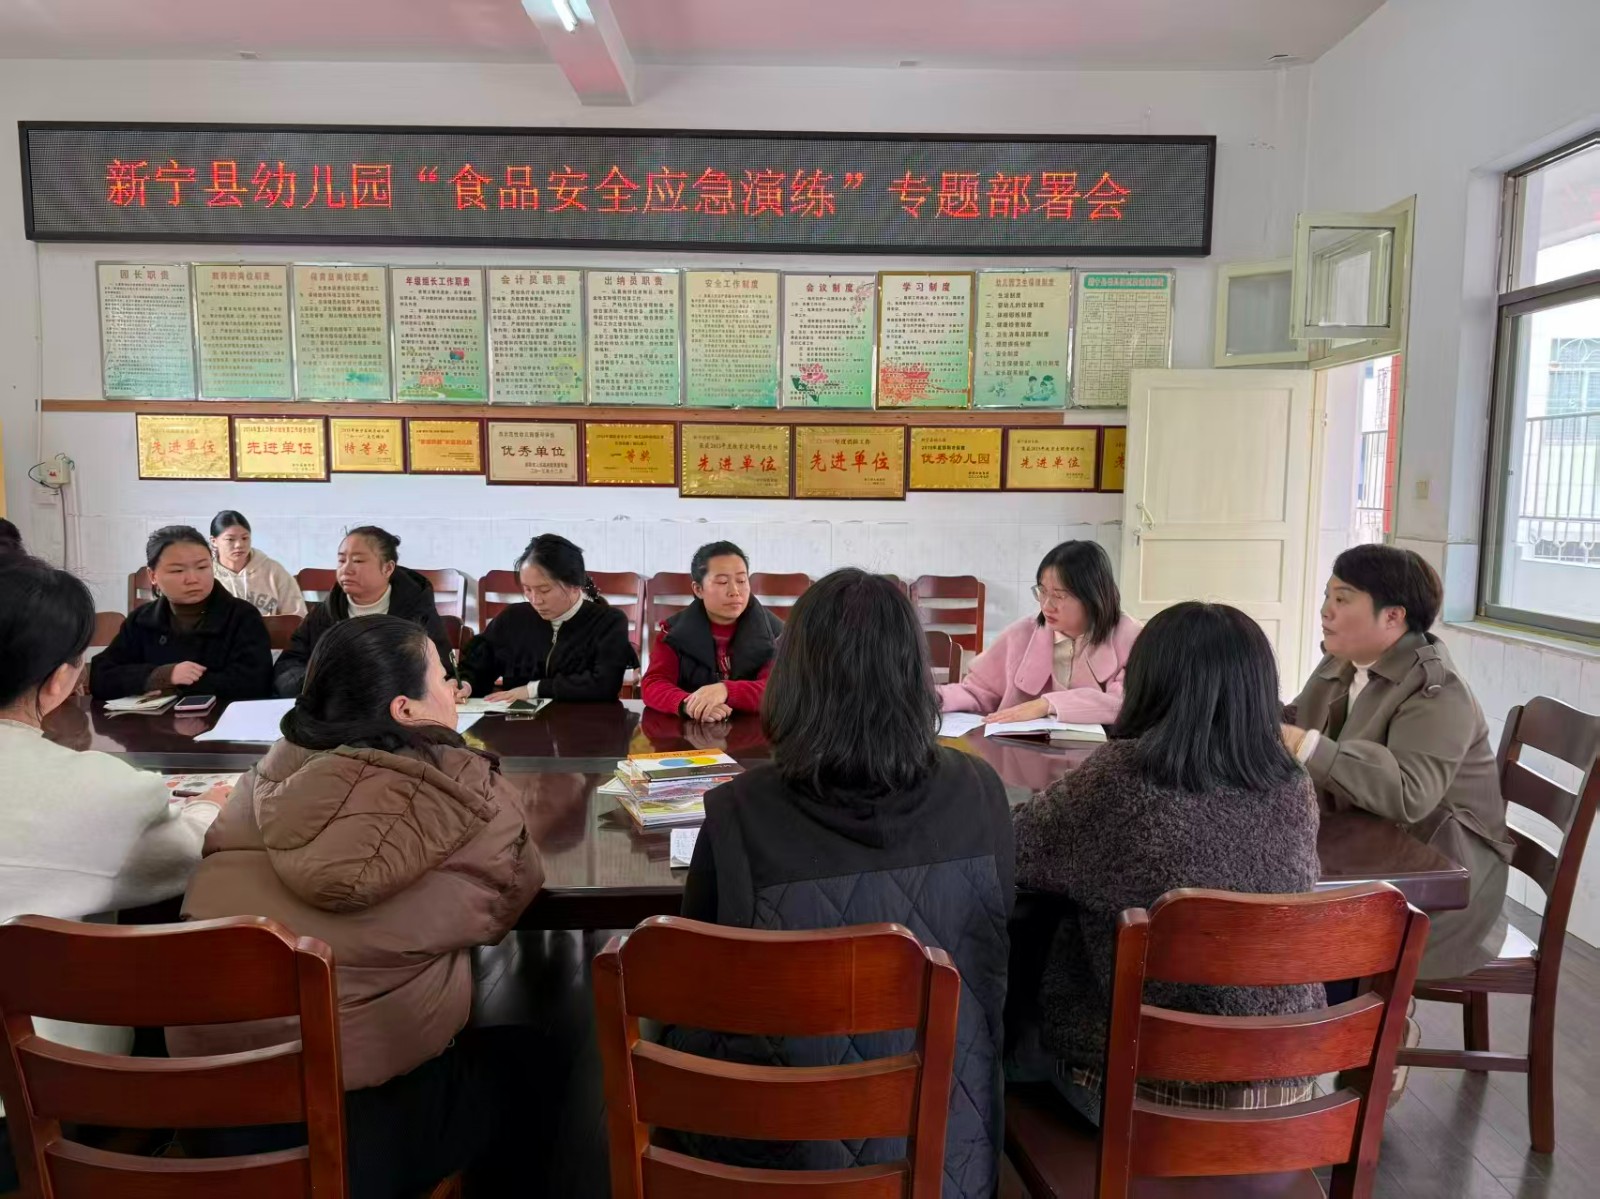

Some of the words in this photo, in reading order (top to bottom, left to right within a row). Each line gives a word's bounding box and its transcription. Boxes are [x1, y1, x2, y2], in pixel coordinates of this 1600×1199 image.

[120, 269, 169, 280] 园长职责
[501, 275, 566, 285] 会计员职责
[405, 276, 471, 286] 年级组长工作职责
[604, 275, 663, 286] 出纳员职责
[705, 279, 759, 289] 安全工作制度
[806, 283, 854, 293] 会议制度
[902, 281, 951, 292] 学习制度
[151, 438, 216, 456] 先进单位
[247, 441, 314, 455] 先进单位
[344, 442, 389, 455] 特等奖
[501, 445, 566, 457] 优秀单位
[610, 449, 651, 463] 一等奖
[810, 449, 890, 473] 先进单位
[921, 453, 990, 464] 优秀幼儿园
[697, 454, 777, 472] 先进单位
[1020, 455, 1080, 469] 先进单位
